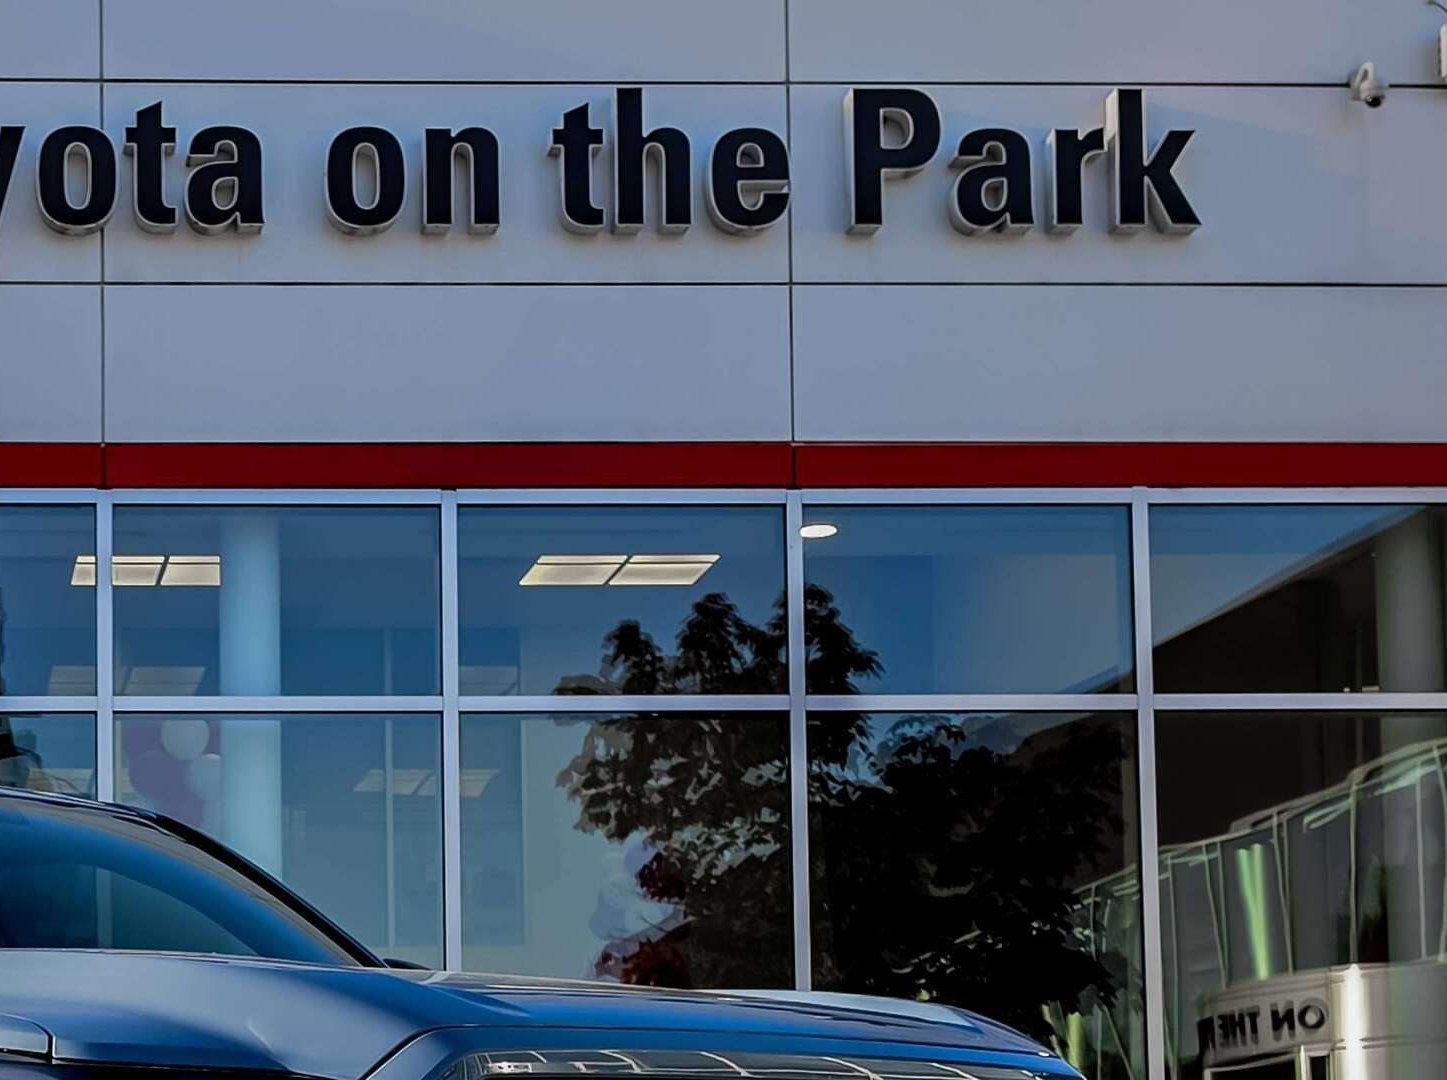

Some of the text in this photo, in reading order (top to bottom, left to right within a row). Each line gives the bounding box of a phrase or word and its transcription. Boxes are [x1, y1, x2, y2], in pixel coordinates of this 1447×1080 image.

[325, 125, 500, 236] on
[548, 87, 791, 236] the
[843, 87, 1201, 236] Park
